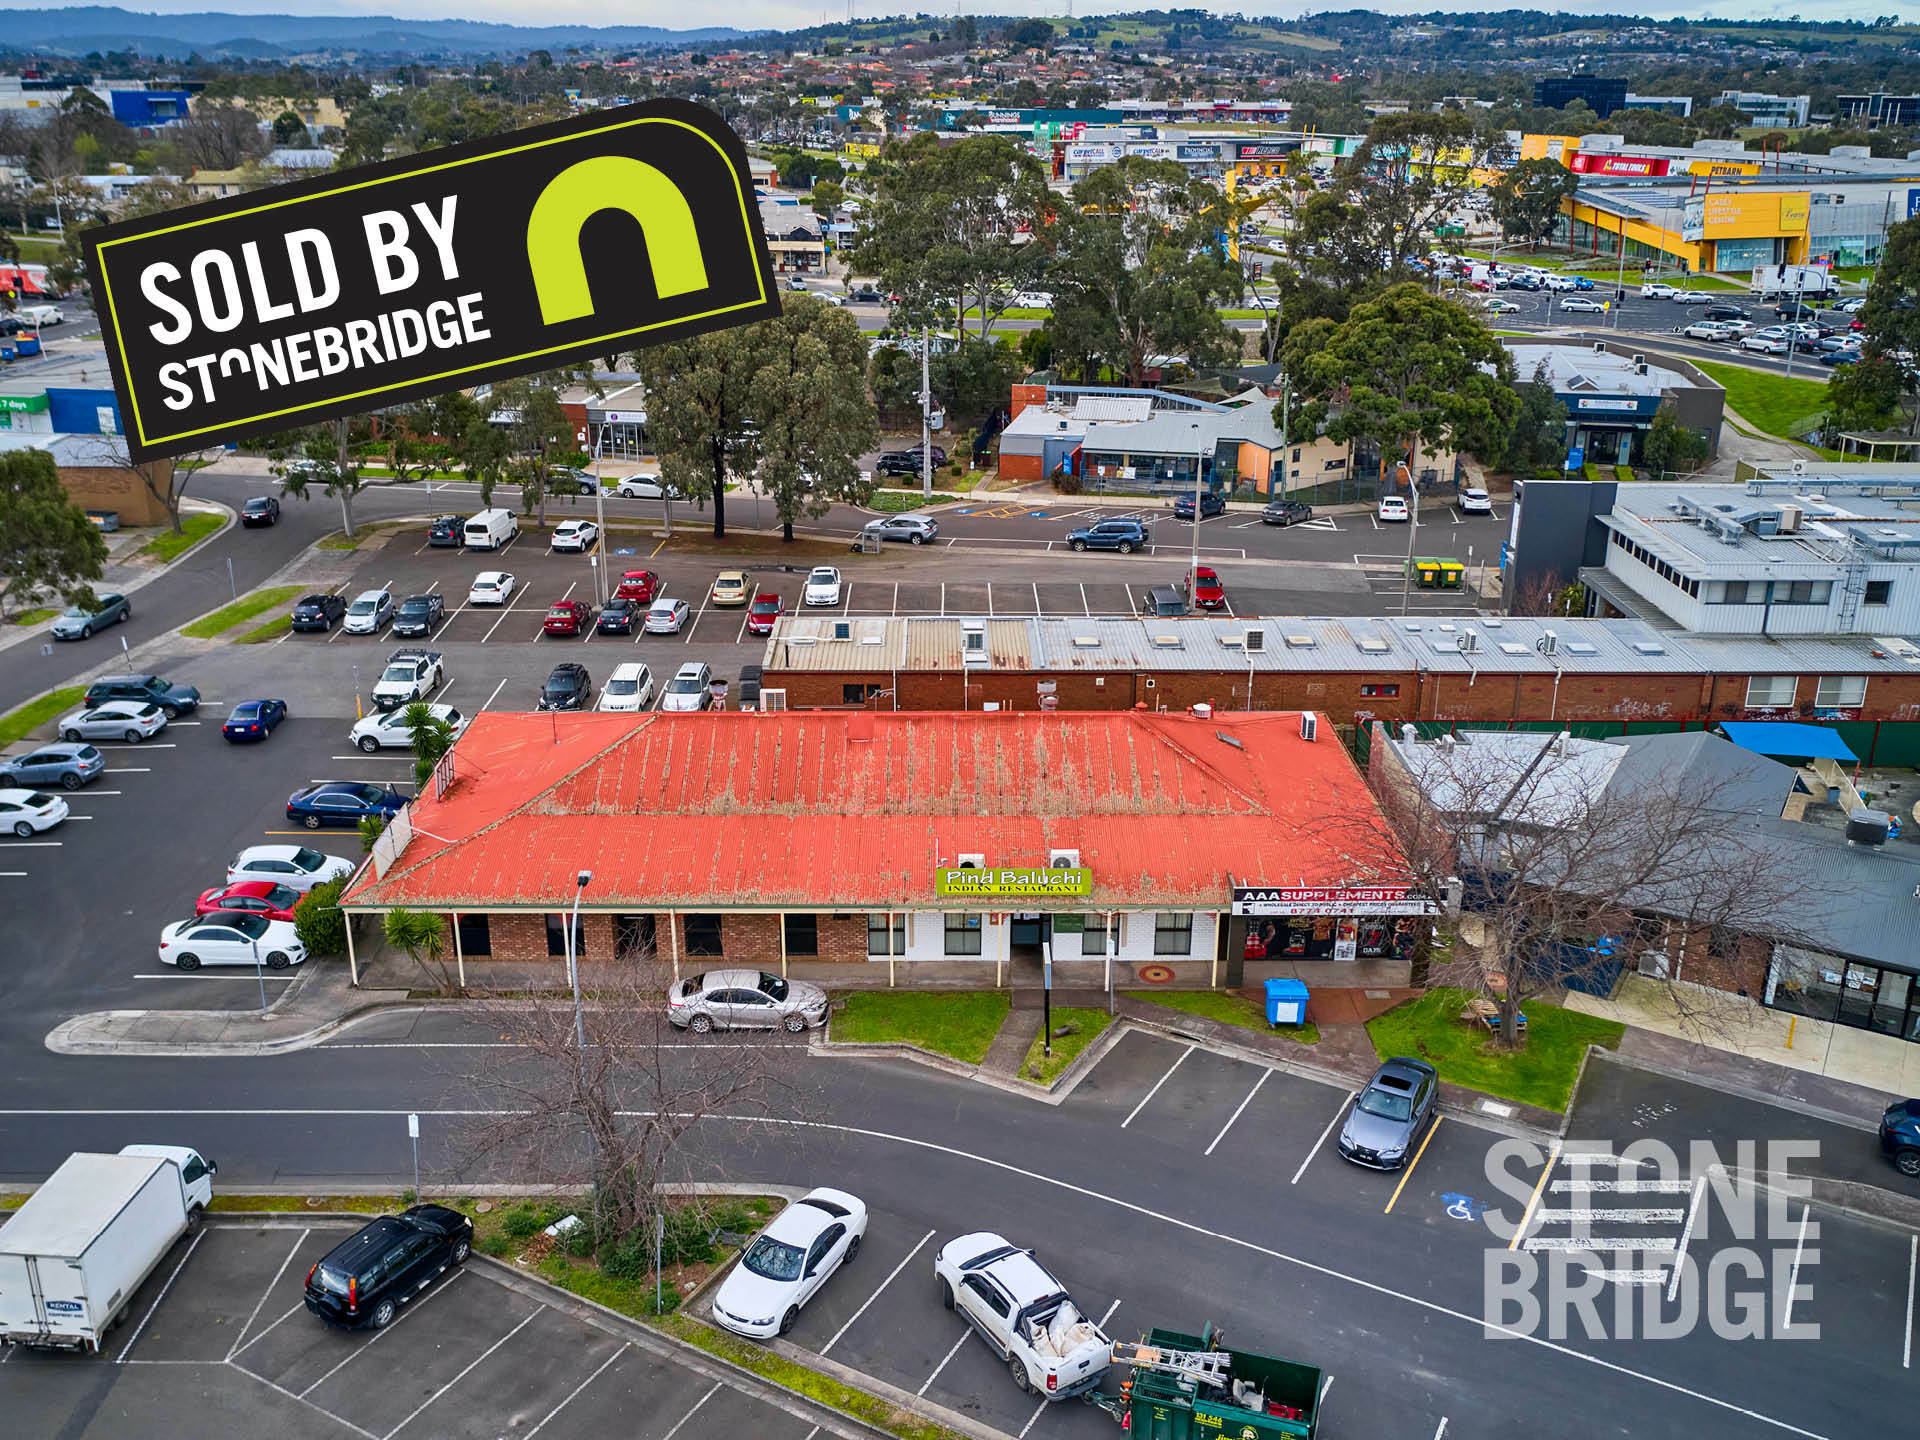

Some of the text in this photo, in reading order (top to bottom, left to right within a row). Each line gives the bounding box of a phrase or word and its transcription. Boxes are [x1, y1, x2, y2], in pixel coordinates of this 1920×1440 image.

[1711, 167, 1742, 175] PETBARN
[946, 871, 1082, 886] Pind Baluchi
